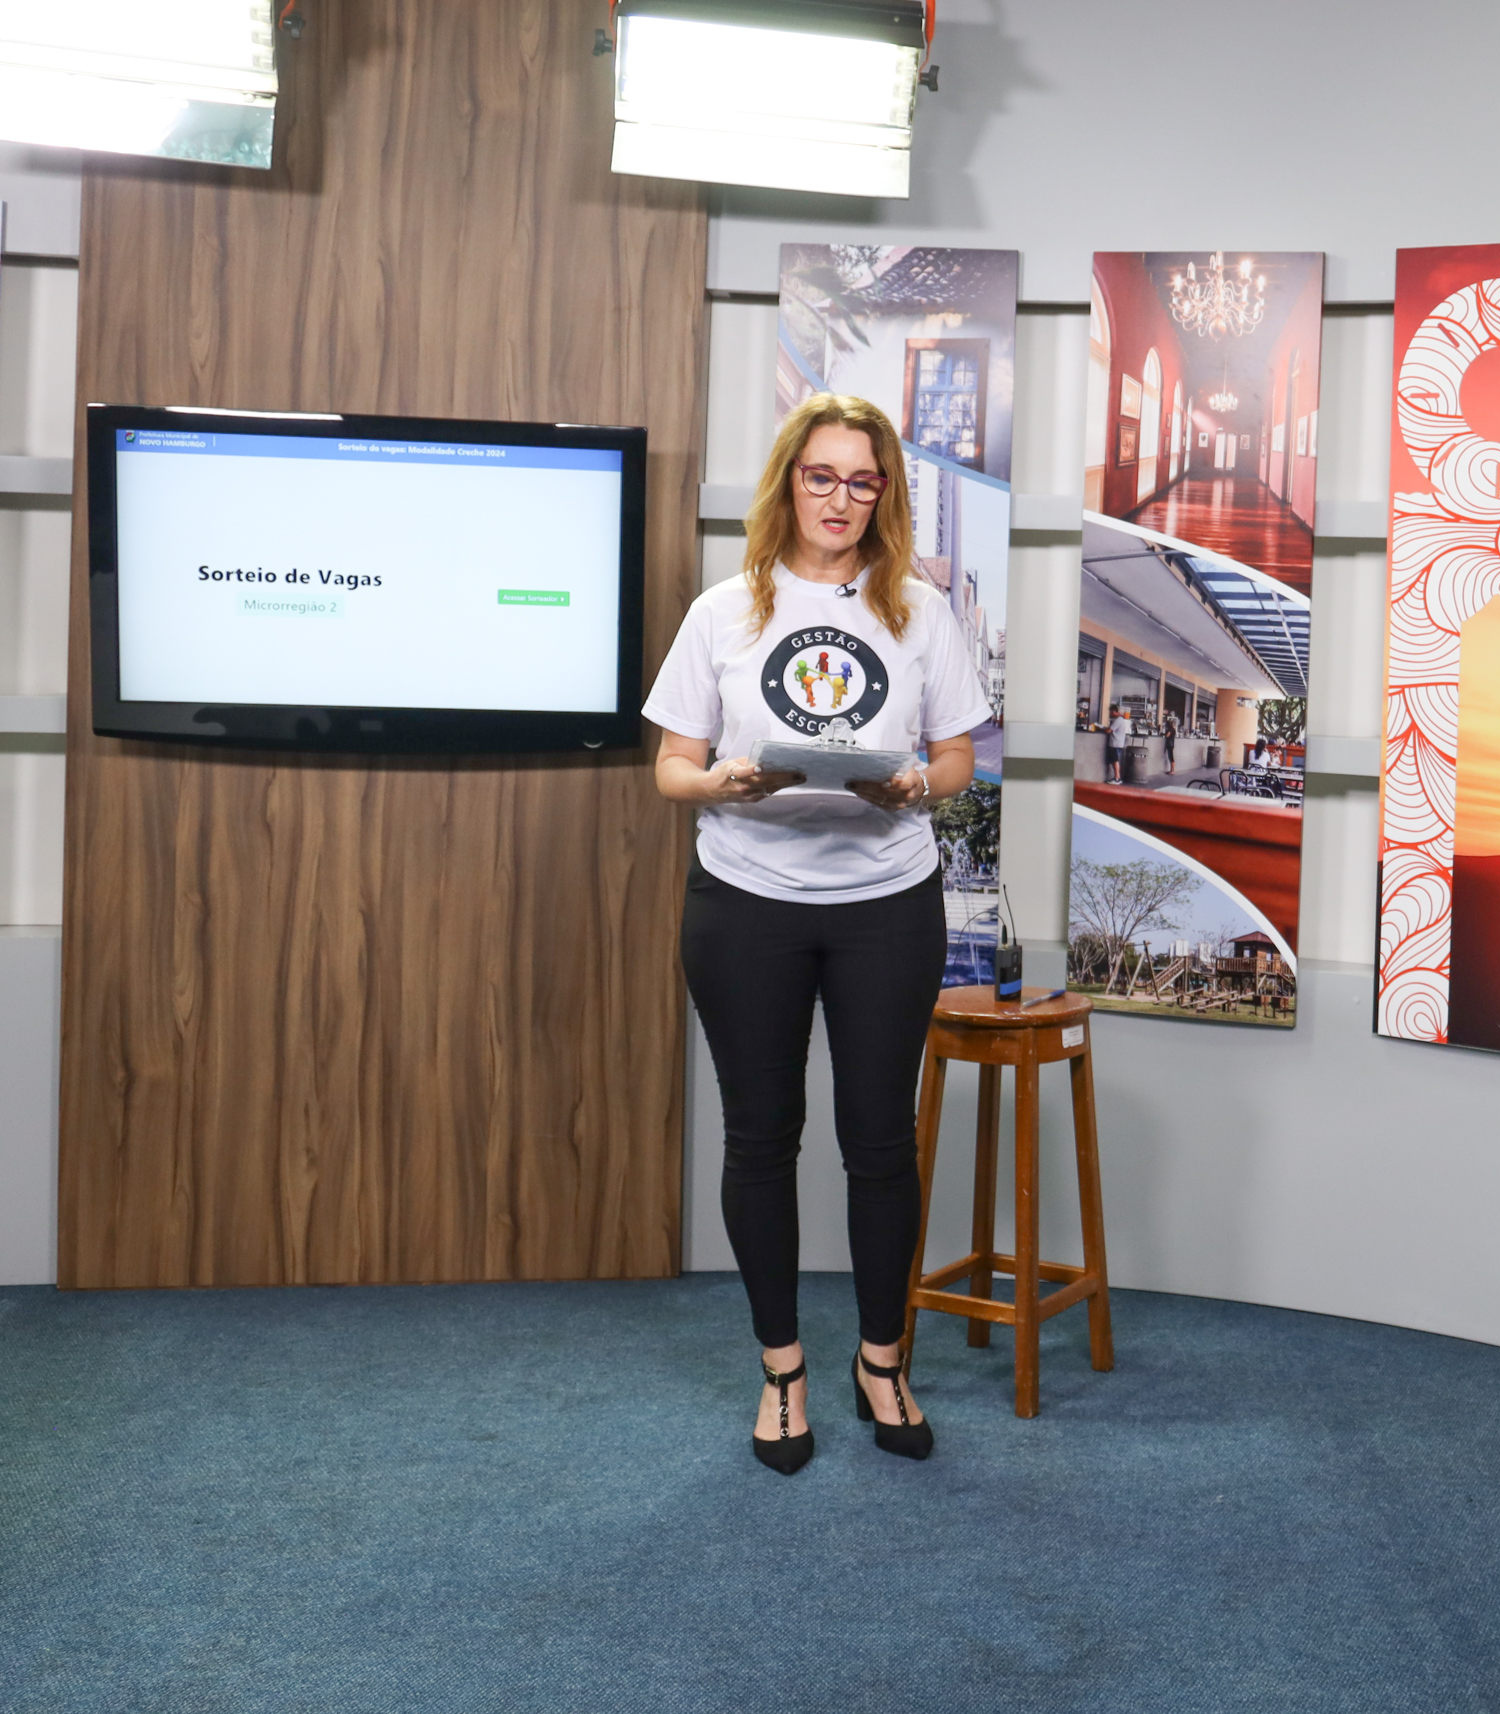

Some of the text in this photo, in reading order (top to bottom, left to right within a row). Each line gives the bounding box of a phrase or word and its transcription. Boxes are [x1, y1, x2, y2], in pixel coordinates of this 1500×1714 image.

[163, 440, 206, 448] HAMBURGO
[338, 442, 506, 457] Sorteio de vagas: Modalidade Creche 2024
[198, 565, 382, 591] Sorteio de Vagas
[244, 599, 337, 614] Microrregião 2
[791, 631, 857, 651] GESTÃO
[785, 709, 863, 733] ESCOR
